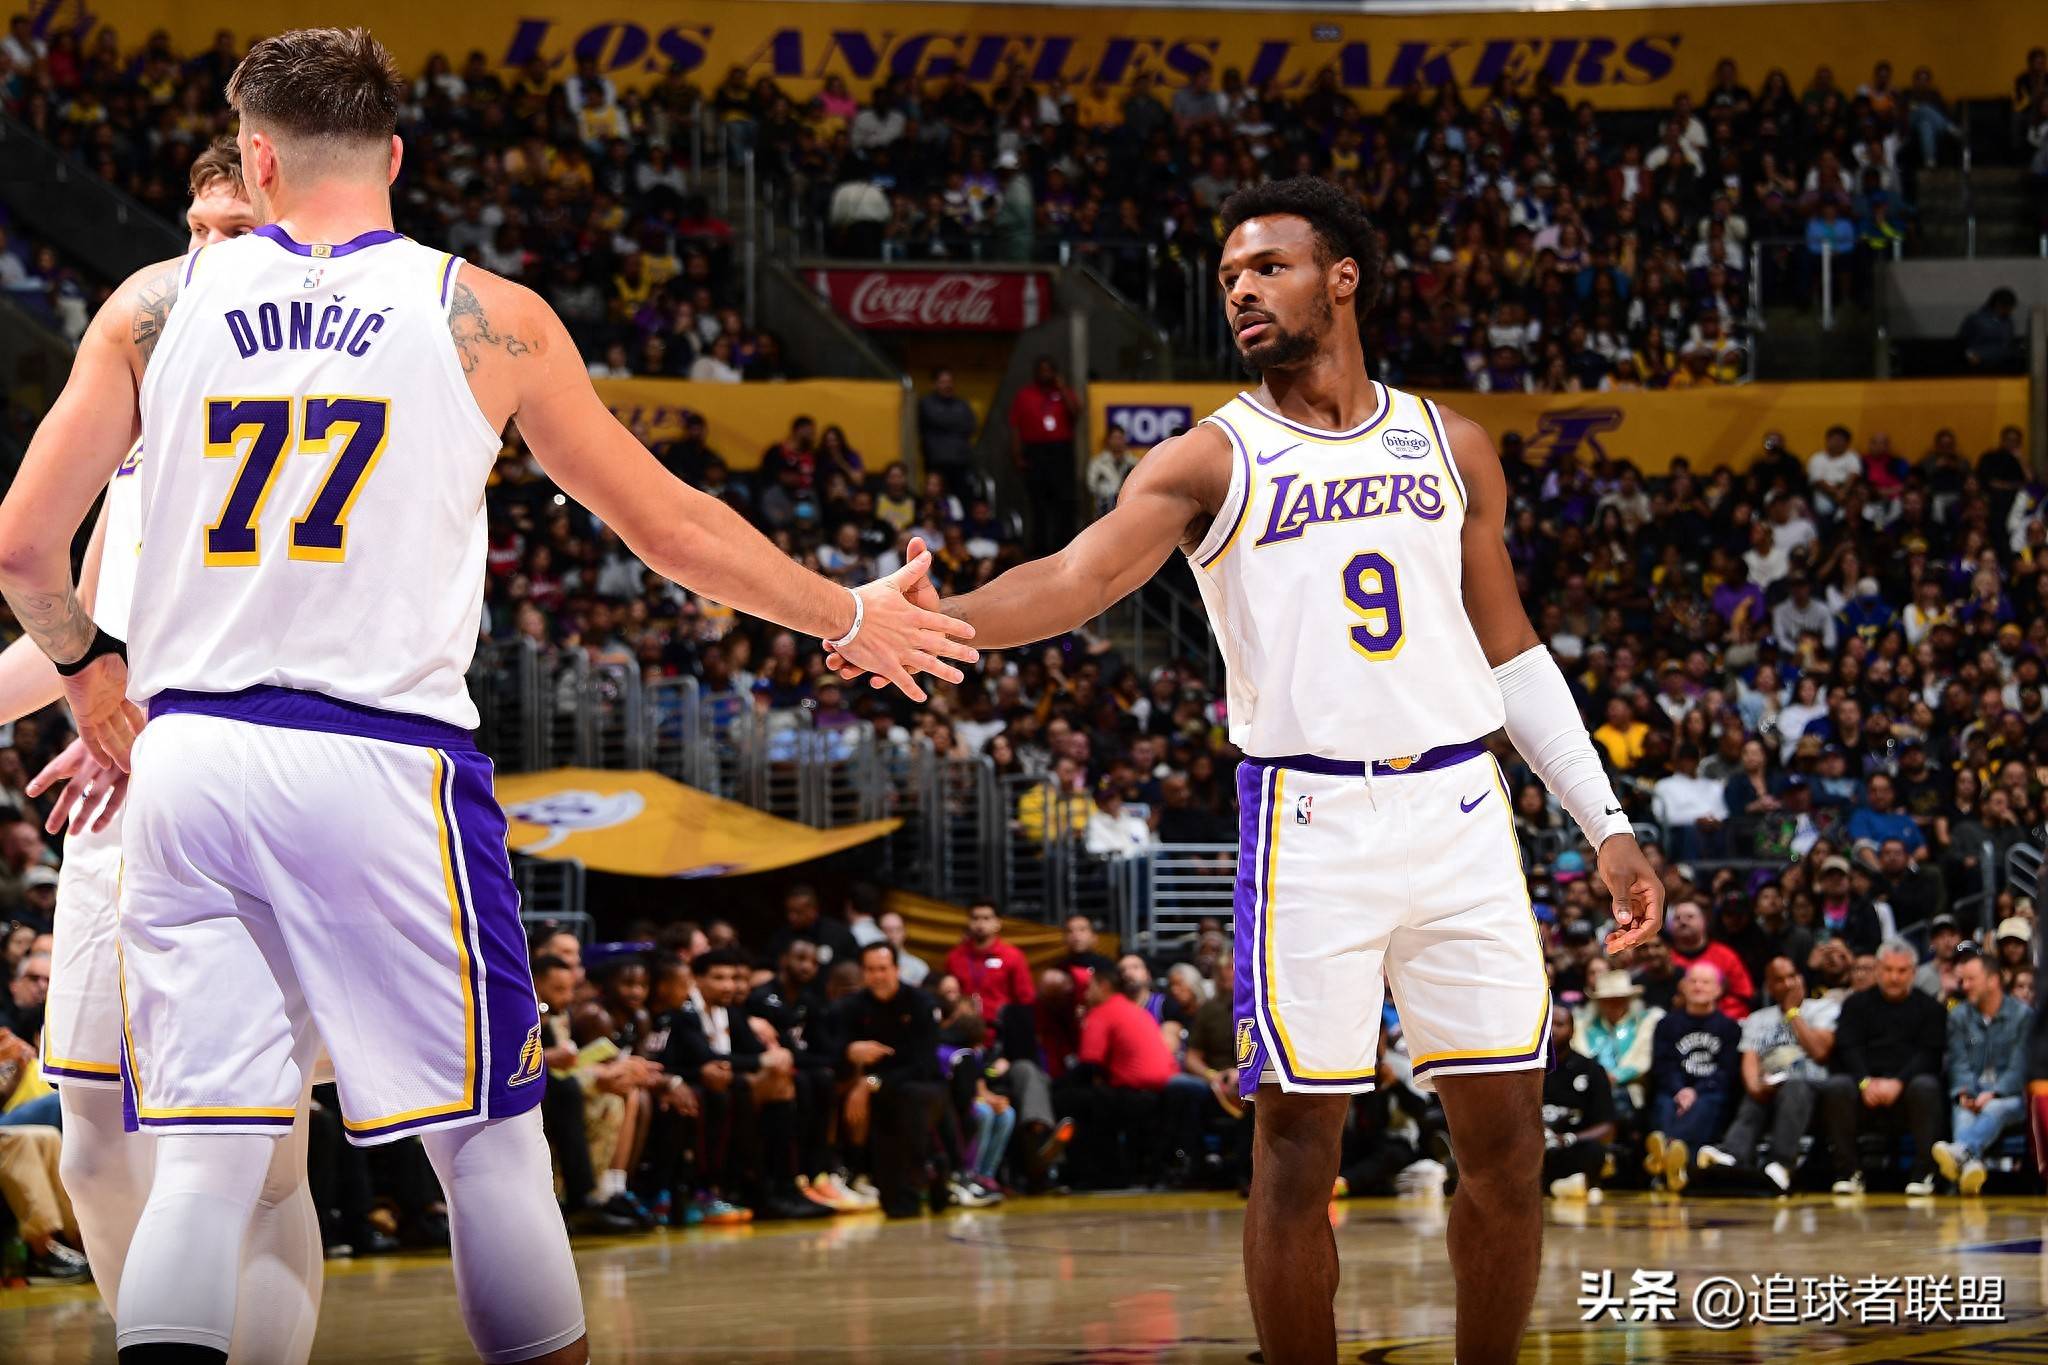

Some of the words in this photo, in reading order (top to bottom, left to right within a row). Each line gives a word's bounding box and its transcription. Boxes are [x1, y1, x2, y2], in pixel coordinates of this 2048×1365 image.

[503, 18, 715, 75] LOS
[738, 29, 1219, 89] ANGELES
[1246, 33, 1683, 90] LAKERS
[225, 294, 394, 360] DONČIĆ
[852, 273, 1000, 325] Coca-Cola
[1386, 436, 1426, 451] bibigo
[203, 395, 391, 568] 77
[1253, 473, 1446, 549] LAKERS
[1340, 549, 1406, 662] 9
